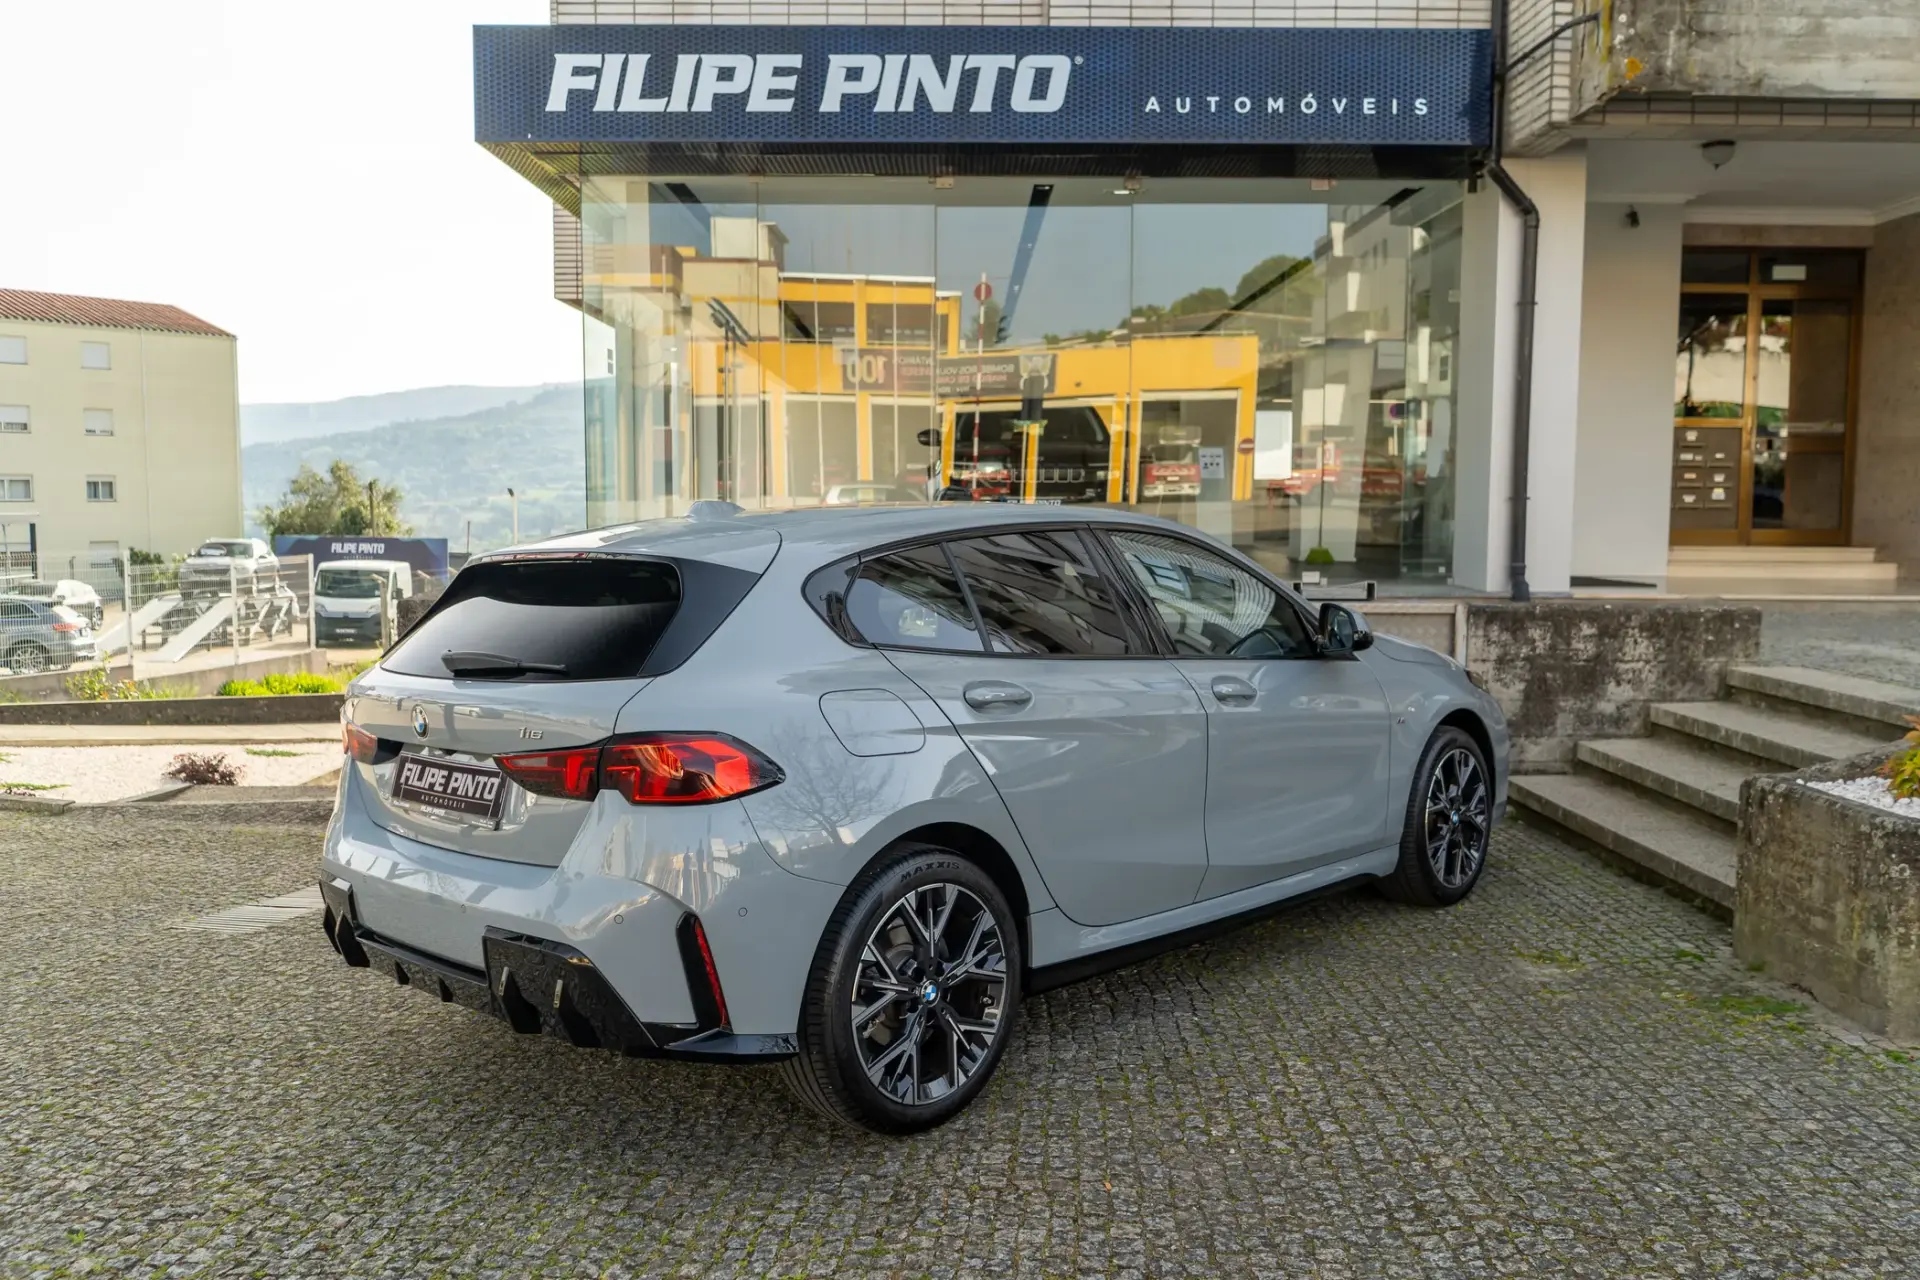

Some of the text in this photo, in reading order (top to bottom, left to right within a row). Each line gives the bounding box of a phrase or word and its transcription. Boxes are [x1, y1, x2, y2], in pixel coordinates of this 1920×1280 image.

[545, 53, 1072, 113] FILIPE PINTO
[1145, 93, 1428, 115] AUTOMÓVEIS
[331, 542, 385, 555] FILIPE PINTO
[400, 762, 500, 800] FILIPE PINTO
[420, 794, 466, 809] AUTOMÓVEIS
[901, 861, 960, 882] MAXXIS
